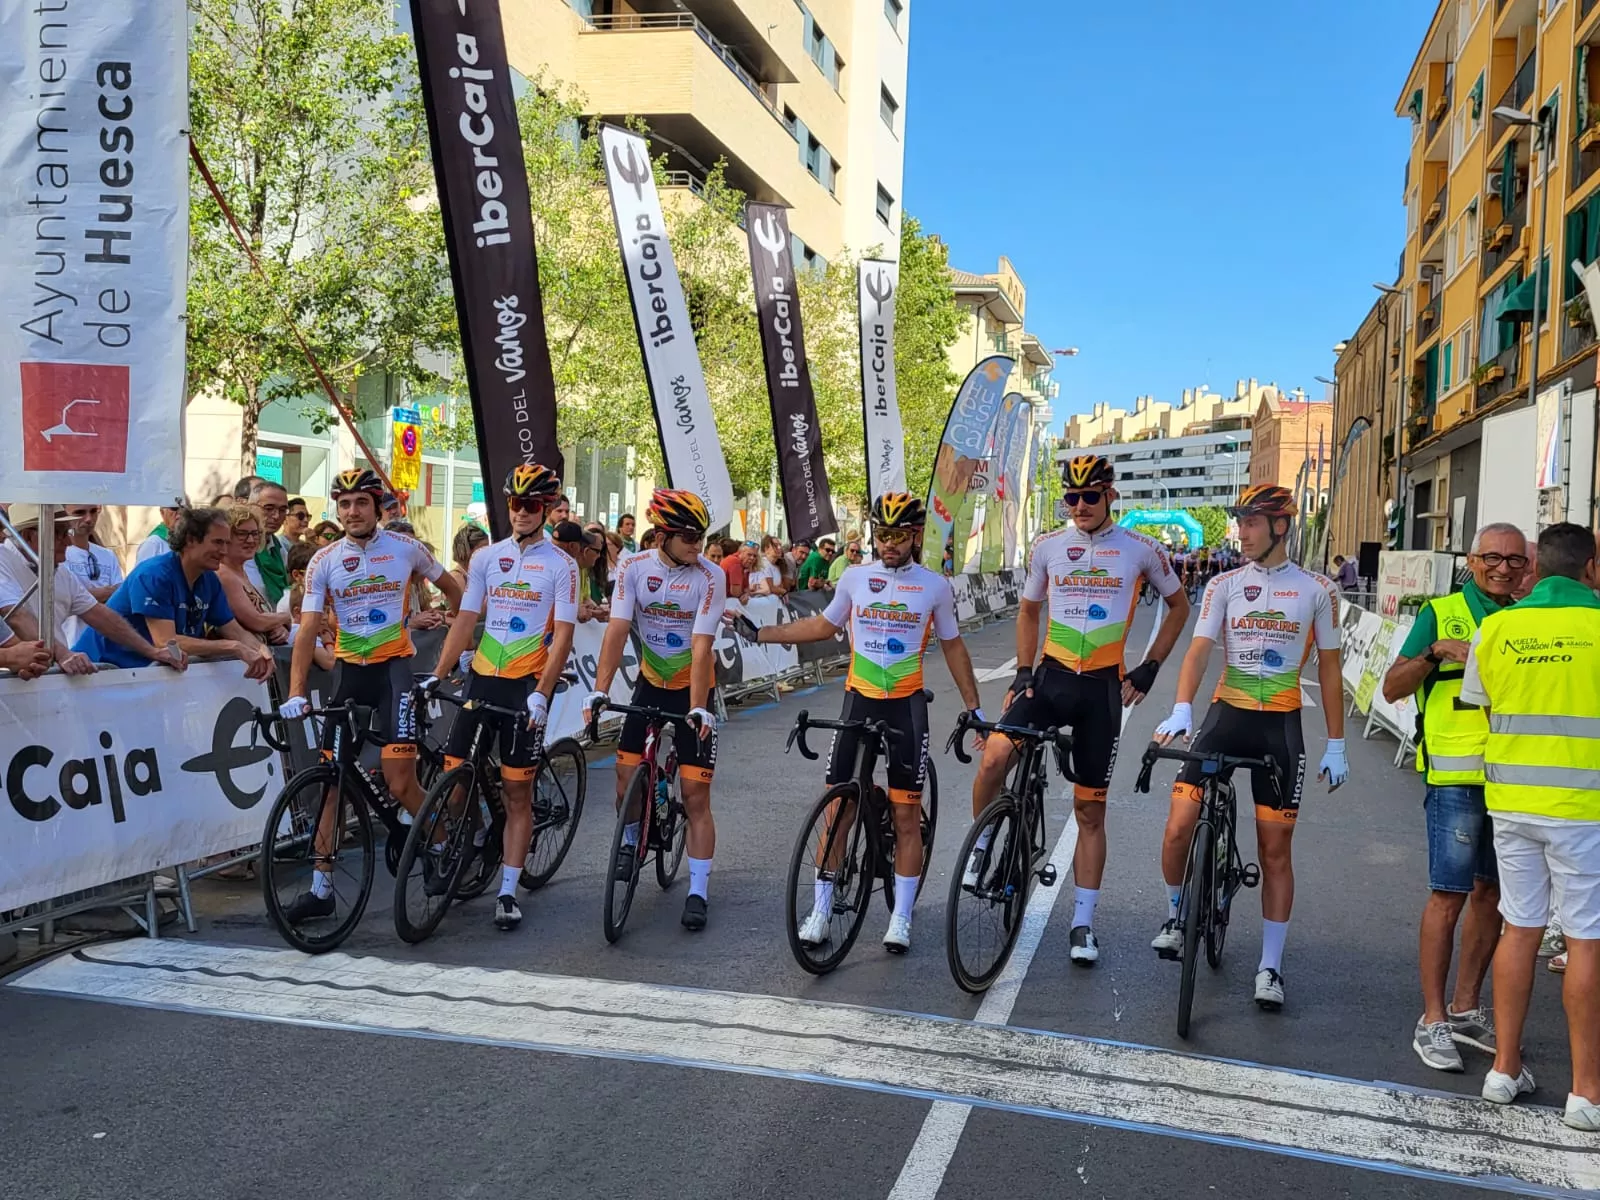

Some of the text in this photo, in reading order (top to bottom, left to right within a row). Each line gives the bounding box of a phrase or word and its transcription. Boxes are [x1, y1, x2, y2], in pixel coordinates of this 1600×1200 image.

[449, 33, 511, 248] iberCaja
[19, 0, 78, 345] Ayuntamient
[83, 60, 134, 348] de Huesca
[633, 214, 675, 348] iberCaja
[769, 277, 799, 387] iberCaja
[493, 294, 537, 465] NCO DEL Vamos
[870, 324, 888, 416] iberCaja
[670, 374, 695, 434] Vamos
[690, 438, 701, 461] DEL
[790, 413, 819, 528] EL BANCO DEL Vamos
[335, 580, 401, 599] LATORRE
[489, 586, 543, 602] LATORRE
[1054, 575, 1123, 588] LATORRE
[639, 607, 694, 619] LATORRE
[856, 604, 922, 623] LATORRE
[1231, 617, 1300, 634] LATORRE
[1513, 637, 1538, 646] VUELTA
[1516, 655, 1572, 664] HERCO
[0, 730, 162, 823] Caja
